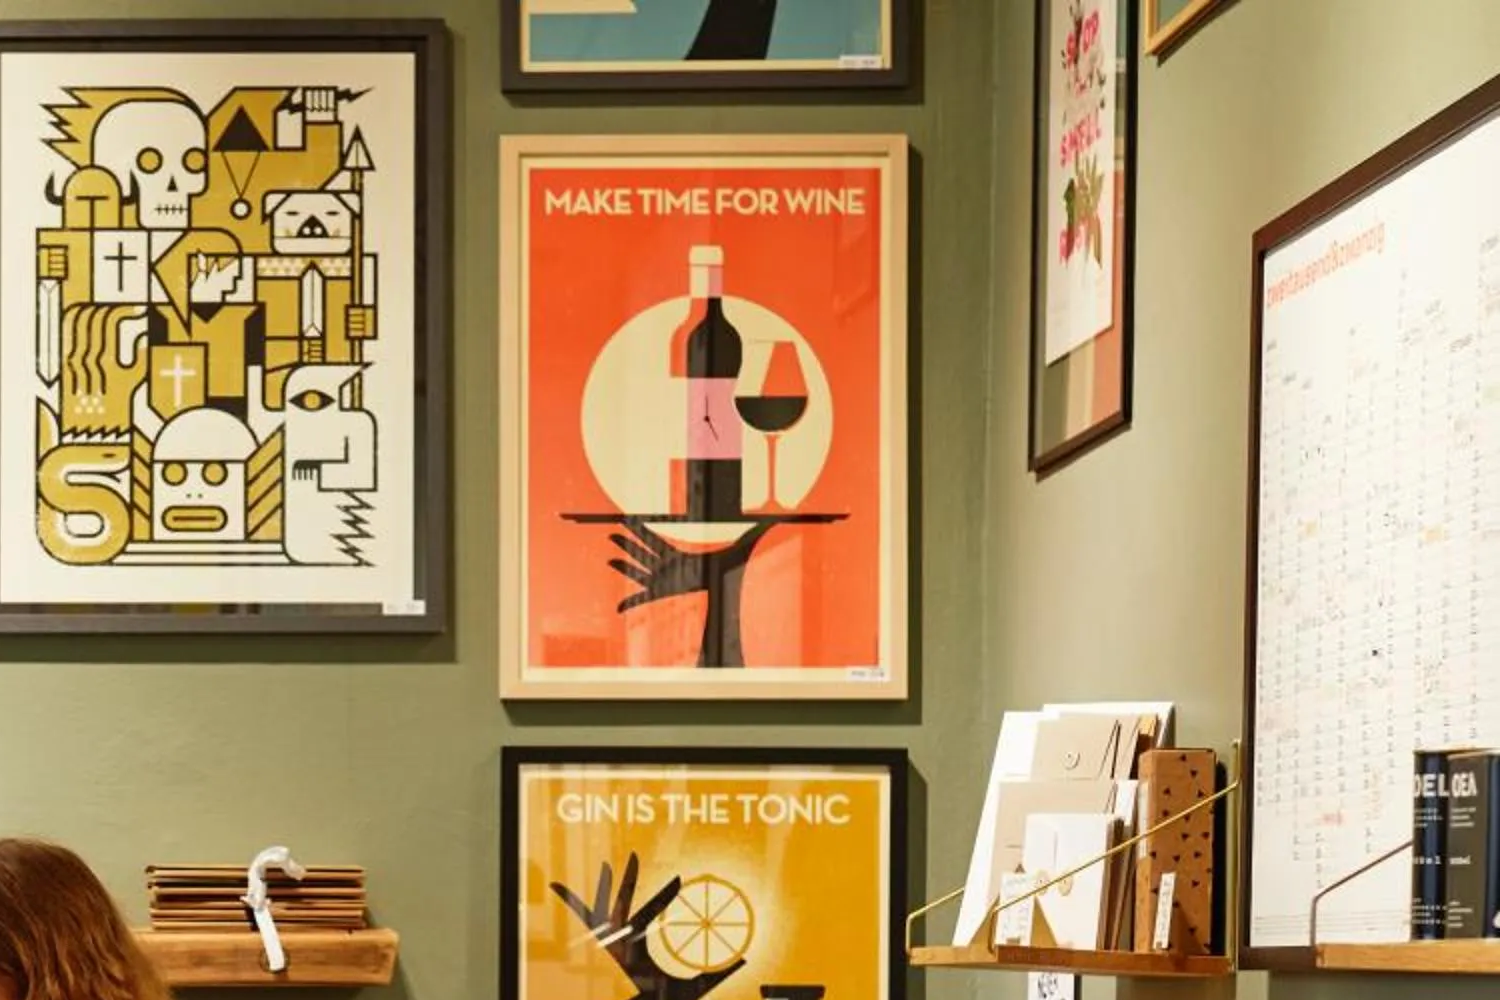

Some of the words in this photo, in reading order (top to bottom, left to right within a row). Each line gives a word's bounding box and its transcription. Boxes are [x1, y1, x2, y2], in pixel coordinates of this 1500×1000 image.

[545, 188, 633, 216] MAKE
[637, 188, 710, 216] TIME
[715, 188, 779, 216] FOR
[784, 188, 866, 216] WINE
[556, 793, 619, 825] GIN
[627, 793, 656, 825] IS
[660, 793, 730, 825] THE
[736, 793, 851, 825] TONIC
